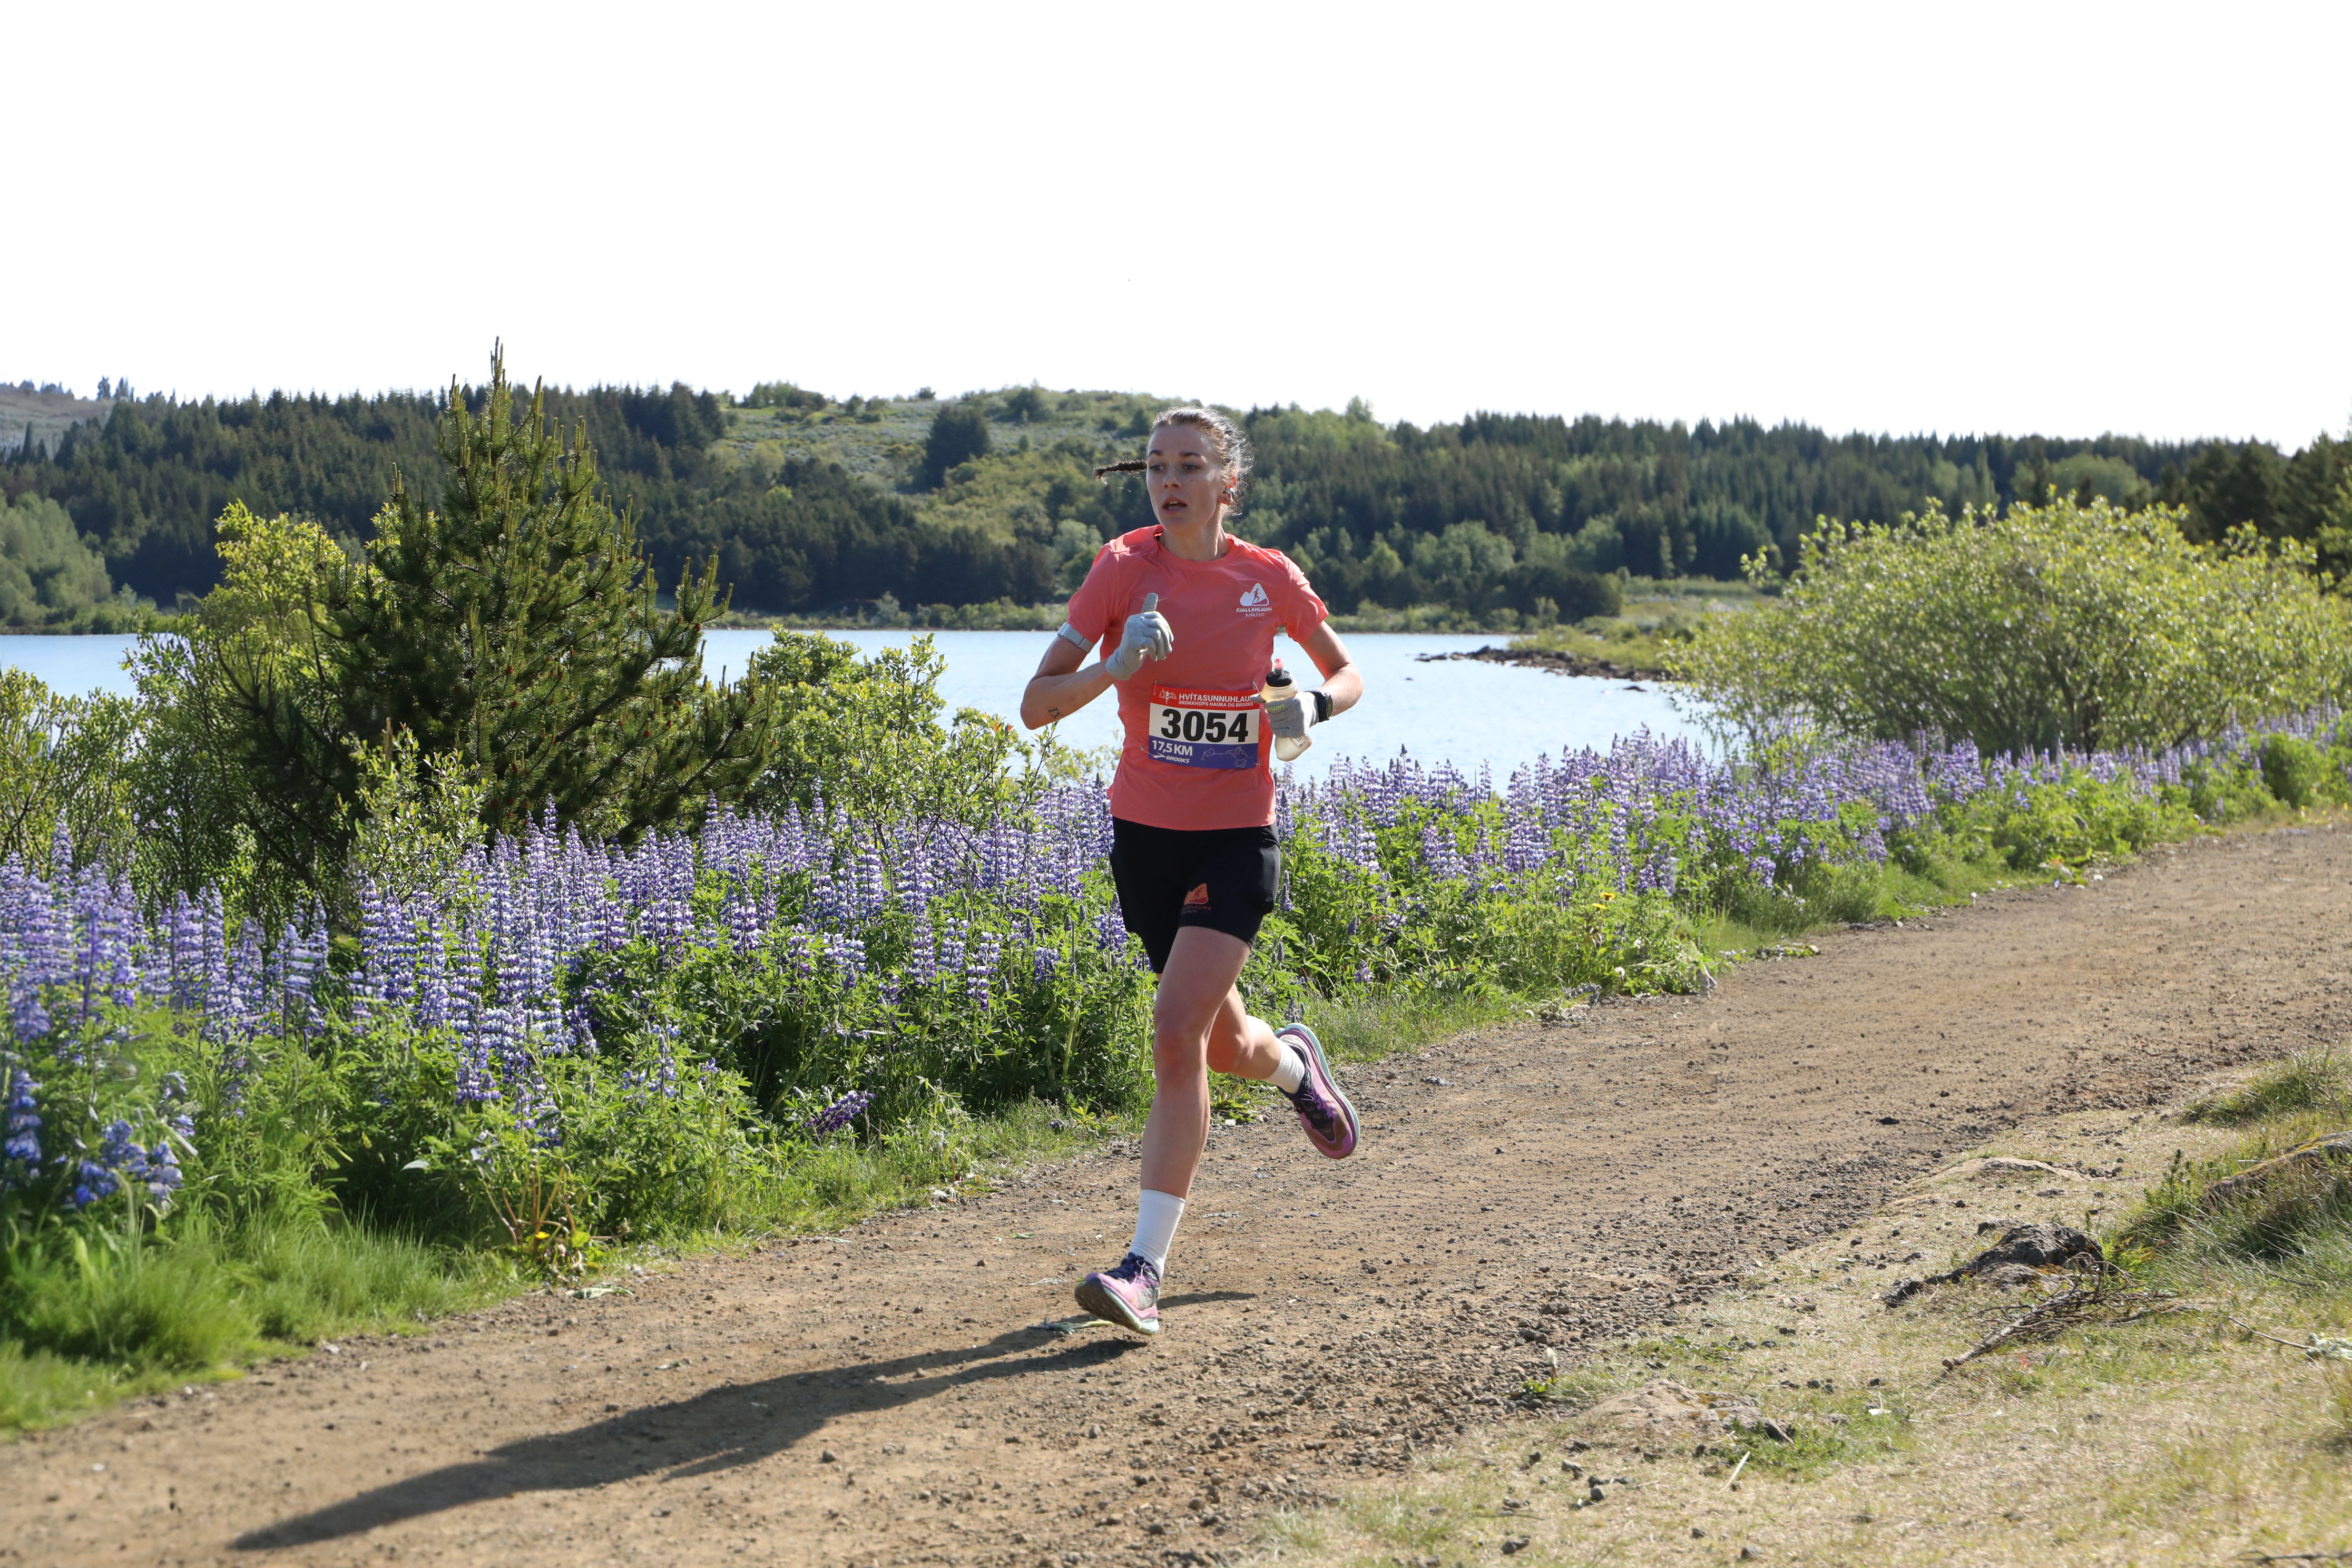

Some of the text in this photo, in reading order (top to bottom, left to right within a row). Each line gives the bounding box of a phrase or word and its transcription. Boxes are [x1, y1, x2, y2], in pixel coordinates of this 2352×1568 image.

[1161, 709, 1248, 743] 3054
[1152, 740, 1193, 756] 17,5 KM
[1165, 755, 1190, 763] BROOKS
